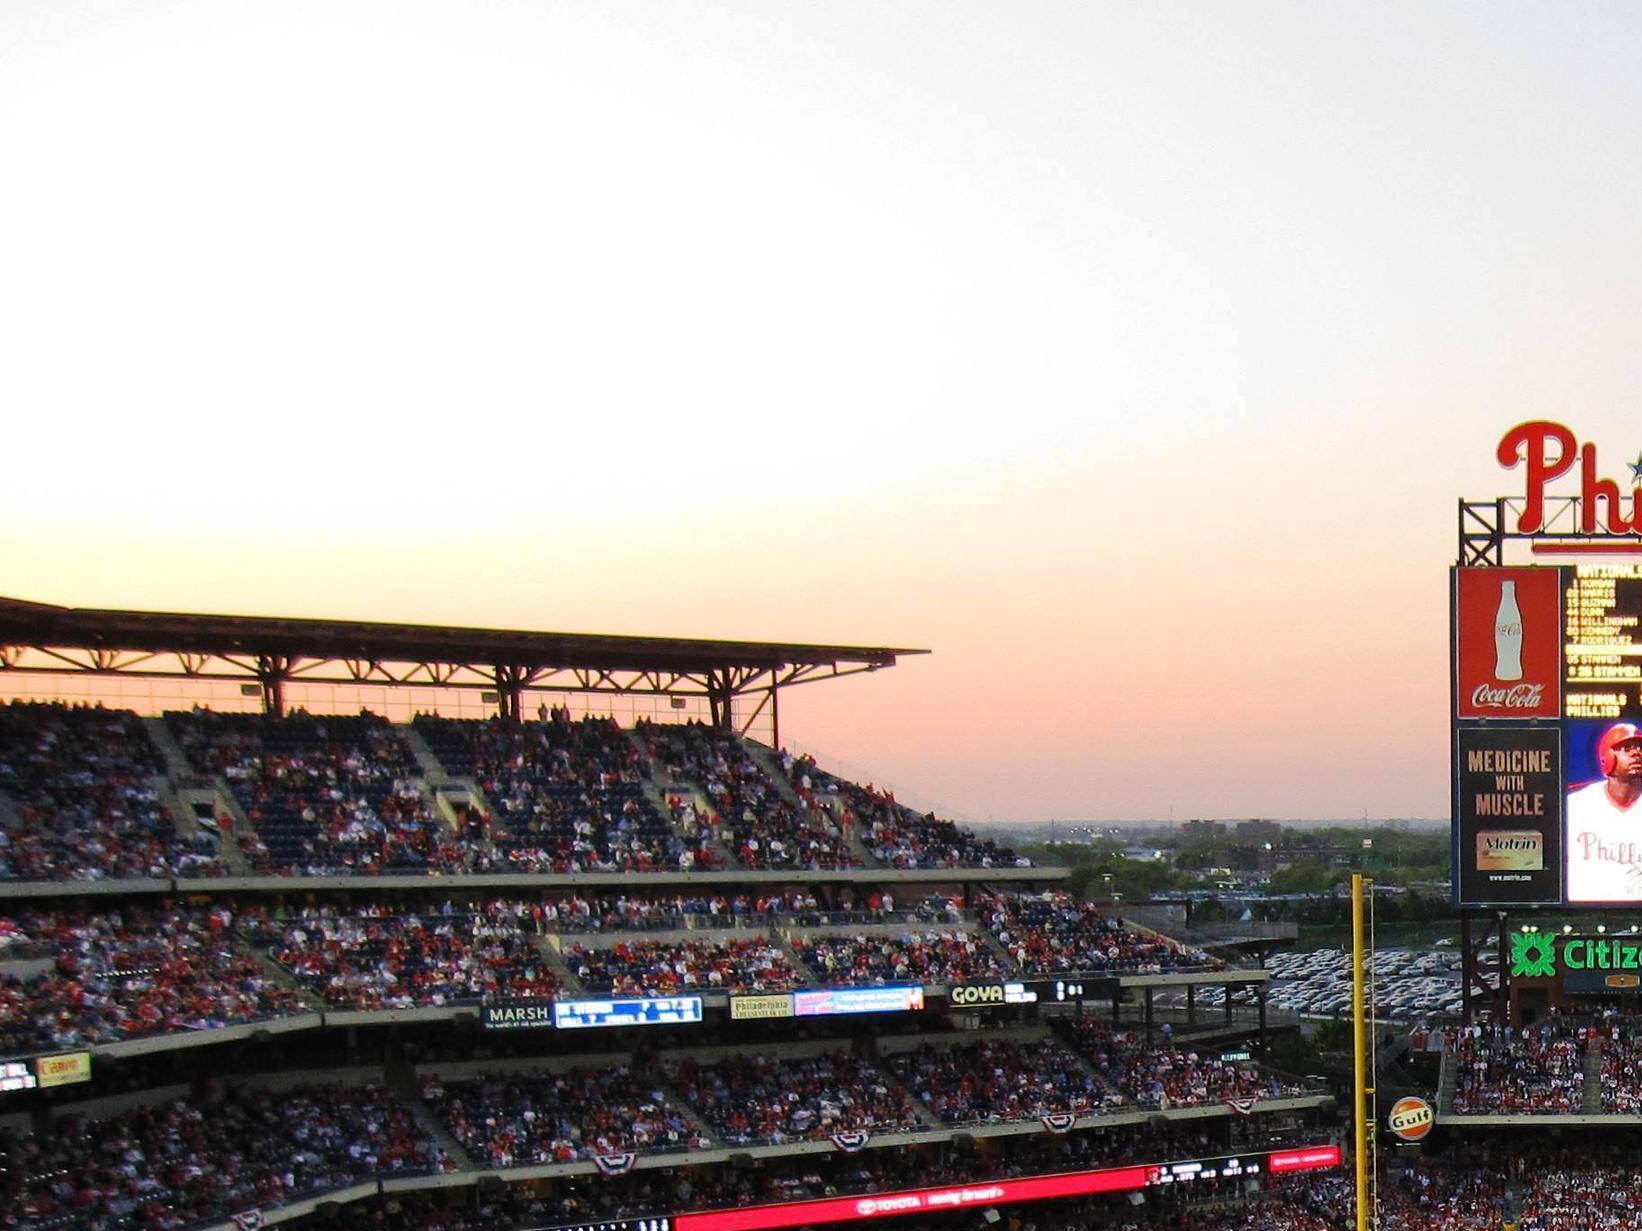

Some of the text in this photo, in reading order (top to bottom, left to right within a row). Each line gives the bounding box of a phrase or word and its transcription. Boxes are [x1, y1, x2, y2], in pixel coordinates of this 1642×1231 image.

[1566, 706, 1620, 717] PHILLIES
[1476, 794, 1544, 816] MUSCLE
[1483, 837, 1537, 850] Motrin
[952, 985, 1003, 1004] GOYA
[490, 1007, 549, 1022] MARSH
[1392, 1110, 1431, 1129] Gulf
[876, 1196, 920, 1211] TOYOTA
